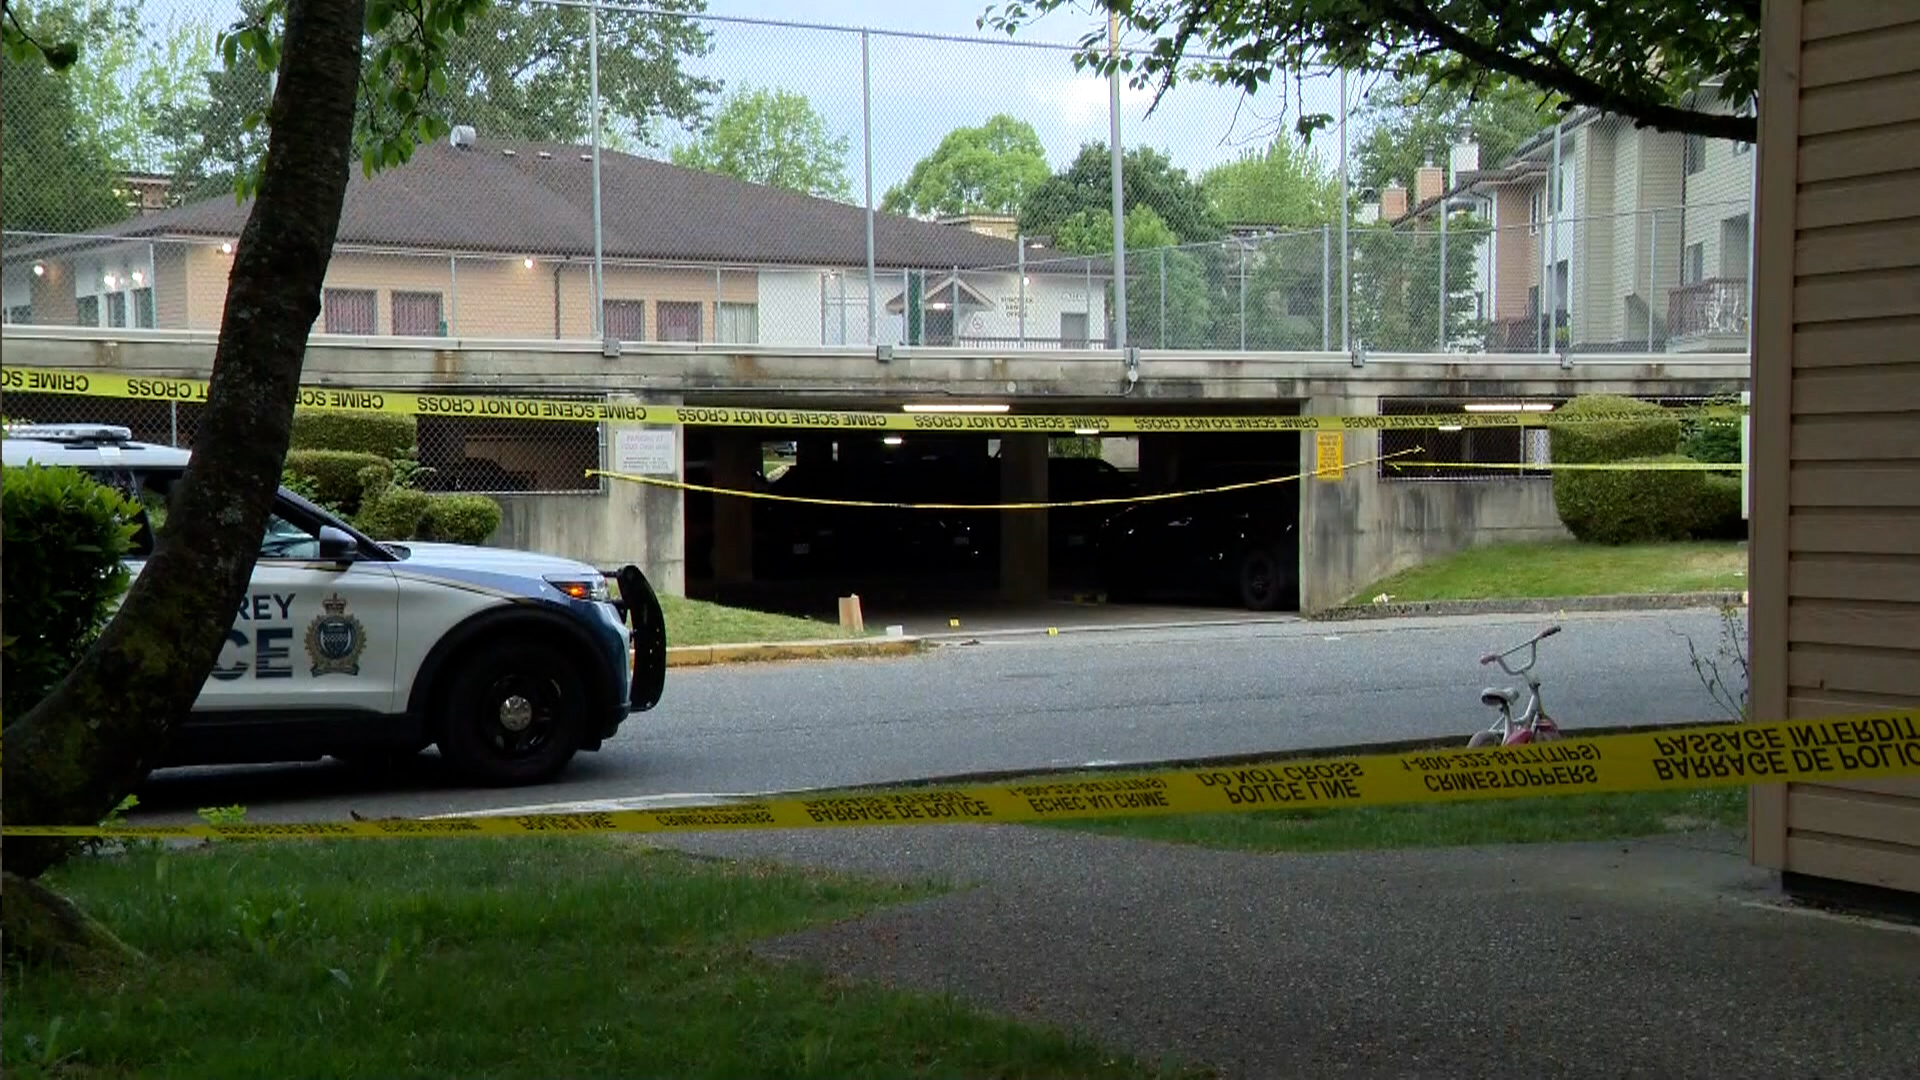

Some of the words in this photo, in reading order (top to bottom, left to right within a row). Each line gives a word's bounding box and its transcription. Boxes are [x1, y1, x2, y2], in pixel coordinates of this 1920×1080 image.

[2, 370, 23, 387] SC
[29, 373, 89, 392] CRIME
[127, 379, 191, 399] CROSS
[296, 391, 327, 405] SCE
[331, 392, 384, 410] CRIME
[418, 397, 474, 413] CROSS
[479, 399, 511, 415] NOT
[515, 401, 538, 416] DO
[542, 403, 595, 419] SCENE
[599, 405, 646, 420] CRIME
[677, 408, 728, 423] CROSS
[733, 410, 763, 424] NOT
[766, 411, 787, 424] DO
[789, 412, 839, 426] SCENE
[840, 413, 887, 427] CRIME
[914, 415, 962, 428] CROSS
[967, 416, 994, 428] NOT
[997, 416, 1016, 428] DO
[1019, 416, 1064, 428] SCENE
[1066, 416, 1109, 429] CRIME
[237, 593, 296, 620] REY
